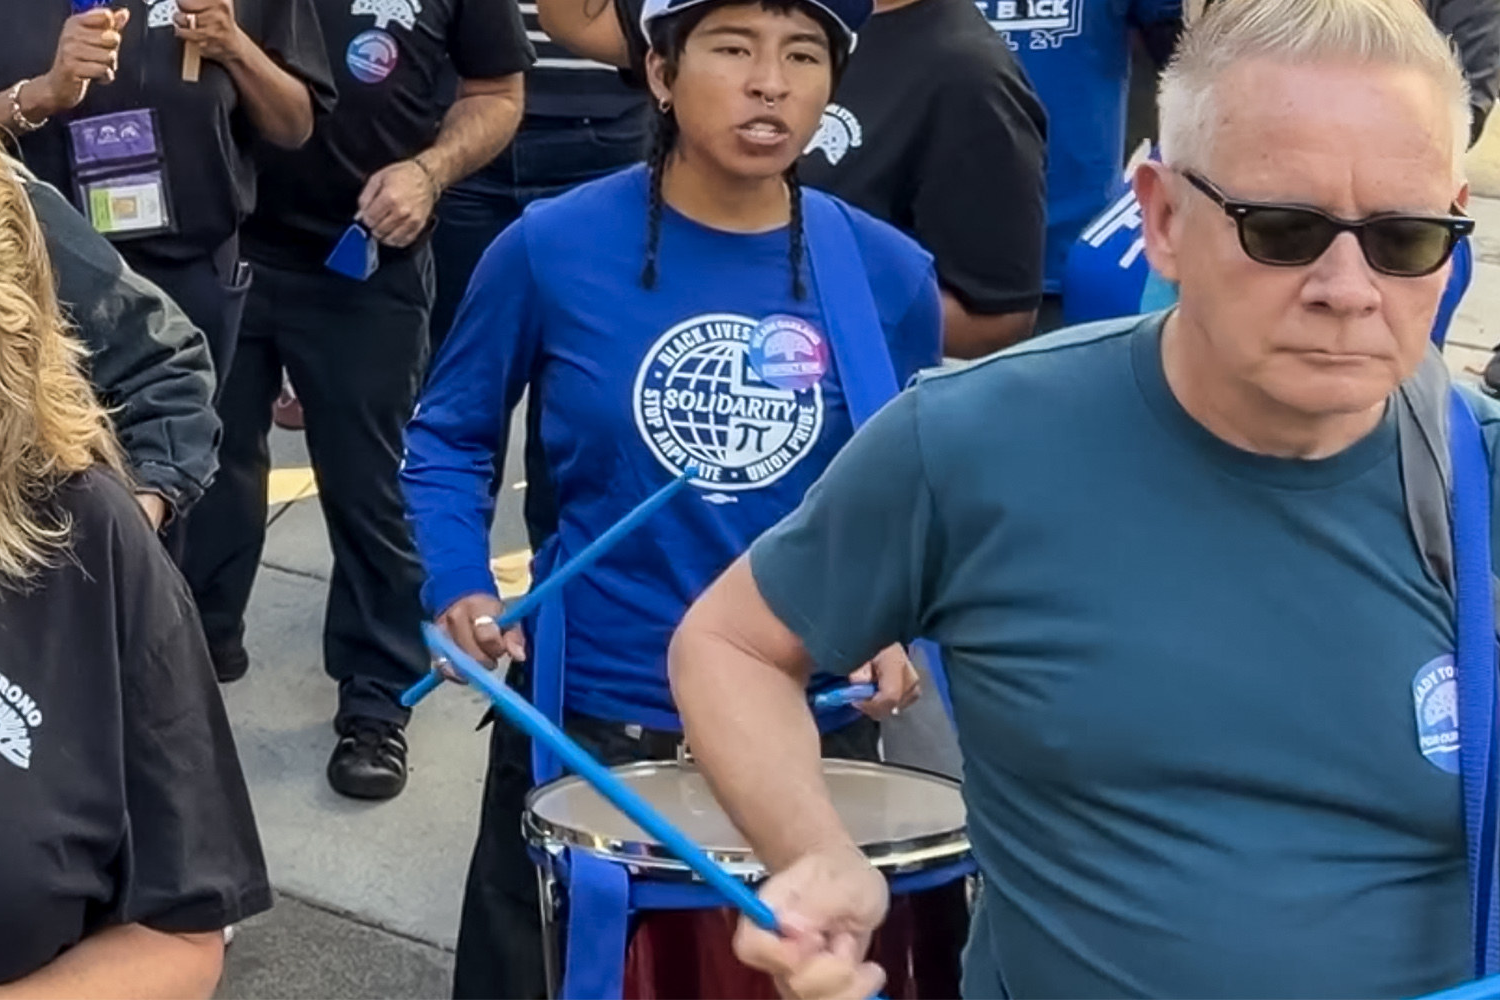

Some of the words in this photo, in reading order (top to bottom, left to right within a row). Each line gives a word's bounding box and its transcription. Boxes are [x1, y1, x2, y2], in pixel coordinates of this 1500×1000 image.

[657, 326, 707, 368] BLACK
[705, 322, 751, 341] LIVES
[643, 388, 663, 429] STOP
[663, 389, 798, 422] SOLIDARITY
[652, 430, 688, 466] AAPI
[744, 447, 793, 482] UNION
[787, 405, 815, 452] PRIDE
